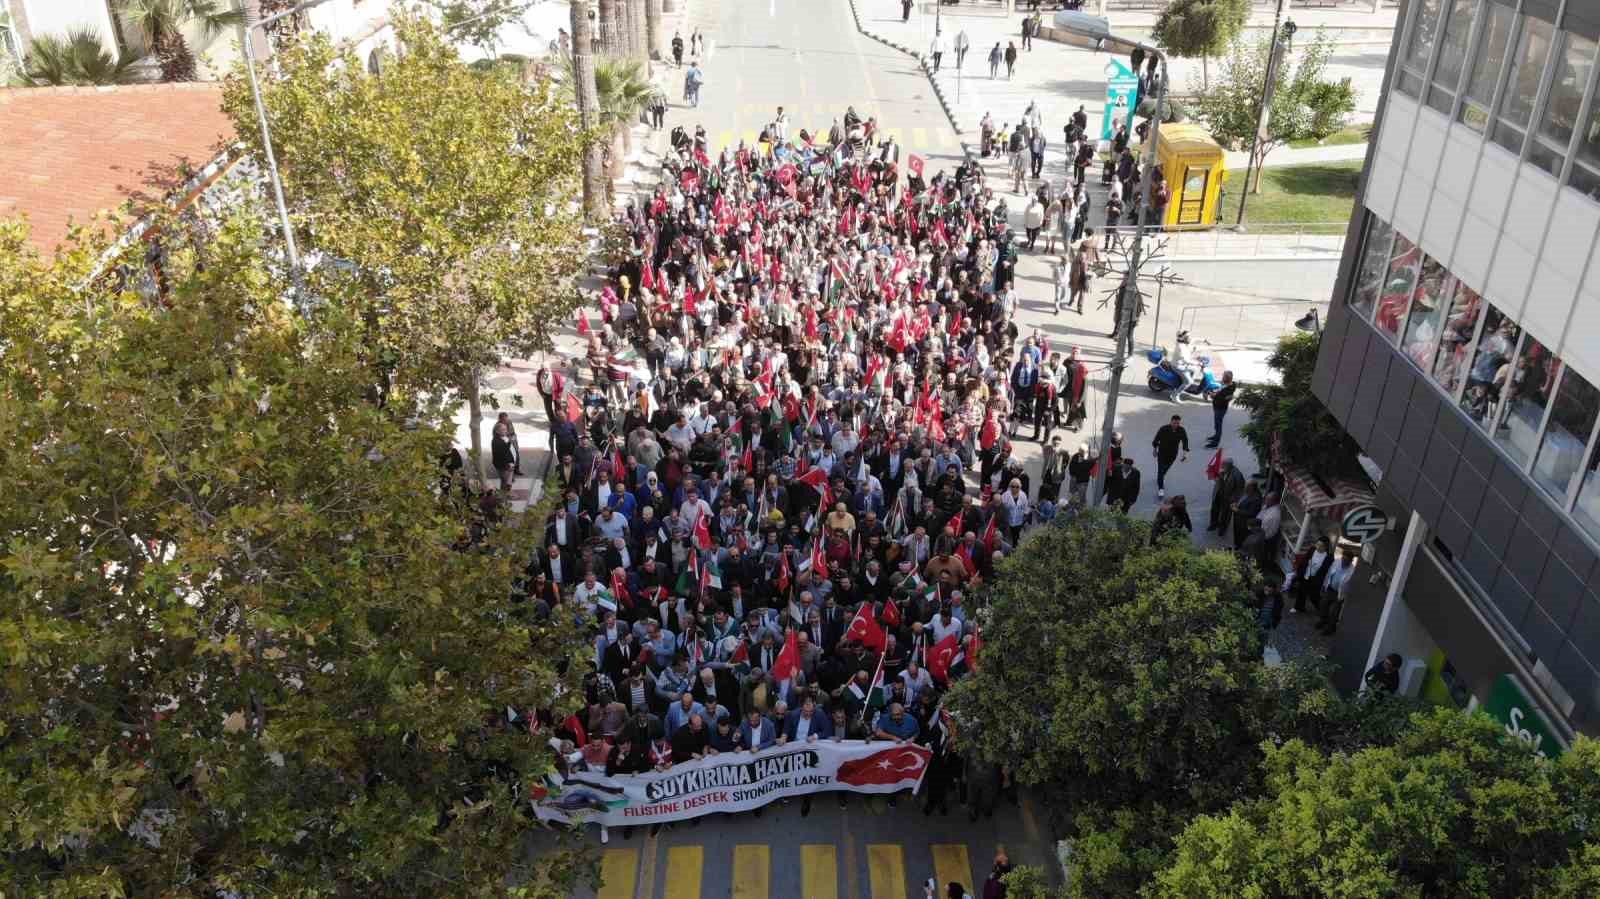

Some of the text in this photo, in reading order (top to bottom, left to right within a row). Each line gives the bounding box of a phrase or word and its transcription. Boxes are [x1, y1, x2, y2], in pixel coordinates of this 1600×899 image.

[652, 752, 812, 799] SOYKIRIMA HAYIR!
[684, 791, 729, 810] DESTEK
[795, 774, 833, 787] LANET
